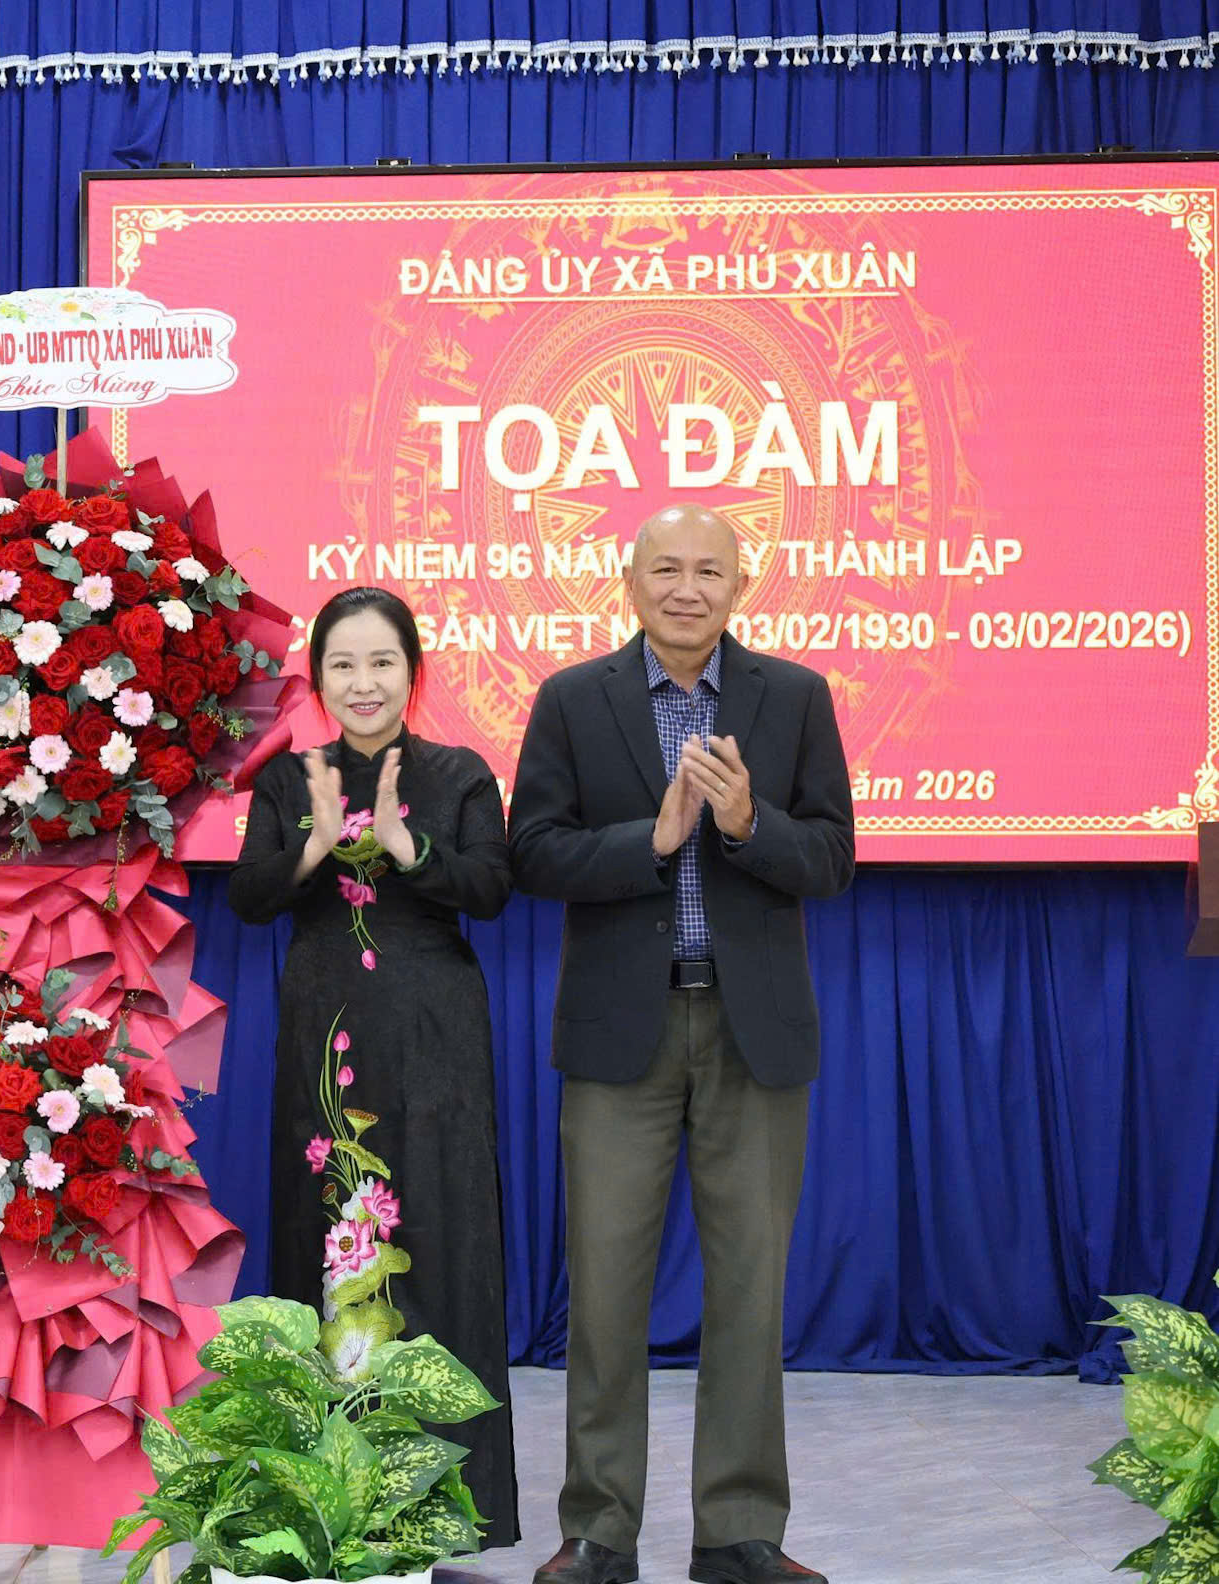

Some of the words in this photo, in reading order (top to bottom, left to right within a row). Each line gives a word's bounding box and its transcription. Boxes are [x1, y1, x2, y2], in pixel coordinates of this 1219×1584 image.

[398, 250, 527, 295] ĐẢNG
[541, 247, 601, 293] ỦY
[612, 246, 674, 292] XÃ
[687, 243, 777, 291] PHÚ
[791, 241, 916, 289] XUÂN
[26, 331, 49, 365] UB
[51, 329, 100, 371] MTTQ
[129, 317, 162, 360] PHÚ
[418, 404, 639, 512] TỌA
[660, 380, 899, 489] ĐÀM
[308, 535, 366, 581] KỶ
[375, 537, 477, 588] NIỆM
[487, 543, 533, 580] 96
[544, 532, 635, 579] NĂM
[779, 530, 926, 577] THÀNH
[938, 533, 1023, 585] LẬP
[416, 606, 497, 652] SẢN
[508, 609, 600, 660] VIỆT
[729, 610, 936, 651] 03/02/1930
[945, 631, 961, 641] -
[969, 610, 1192, 658] 03/02/2026)
[851, 770, 903, 801] ăm
[914, 769, 996, 801] 2026
